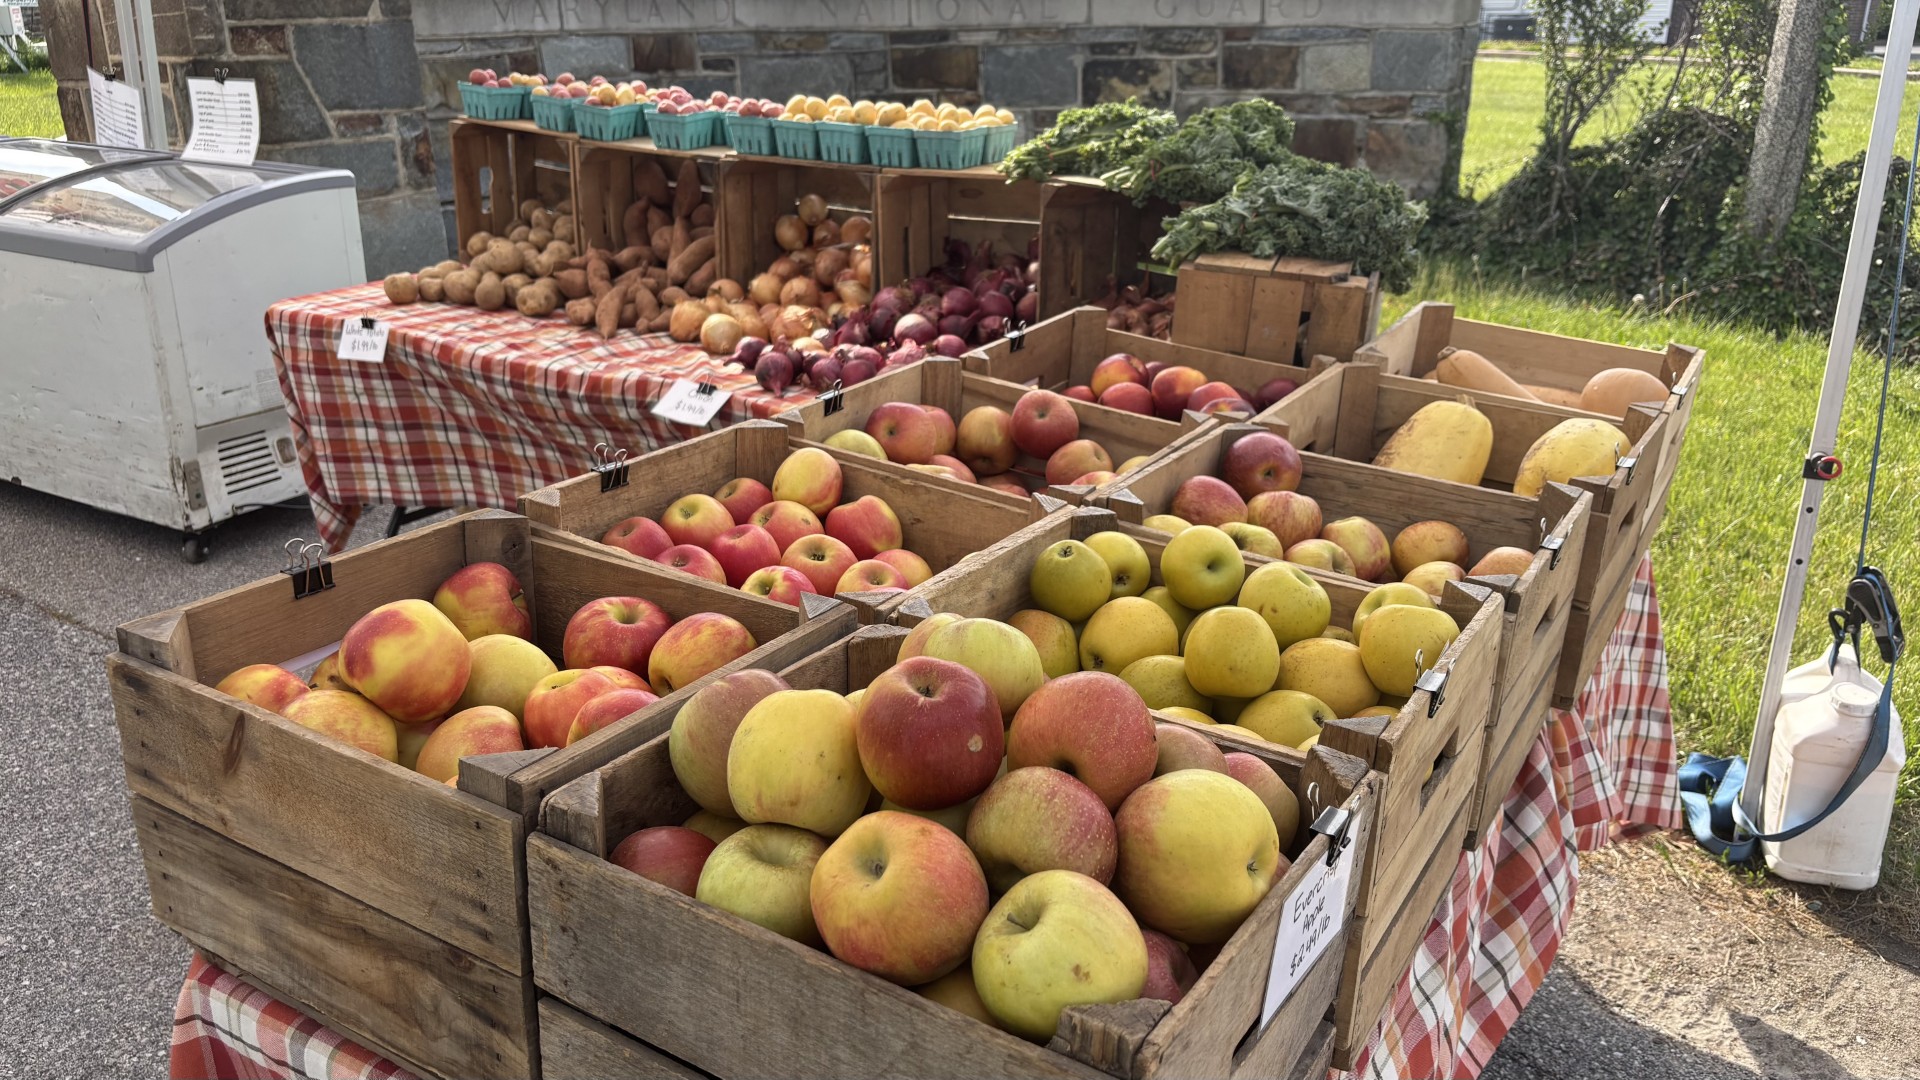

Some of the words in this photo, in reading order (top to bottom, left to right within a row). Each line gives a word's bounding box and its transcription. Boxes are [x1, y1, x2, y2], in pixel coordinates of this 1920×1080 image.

[493, 0, 732, 24] MARYLAND
[819, 0, 1059, 22] NATIONAL
[1153, 0, 1323, 19] GUARD
[1302, 895, 1326, 935] Apple
[1289, 913, 1331, 978] $2.49/lb
